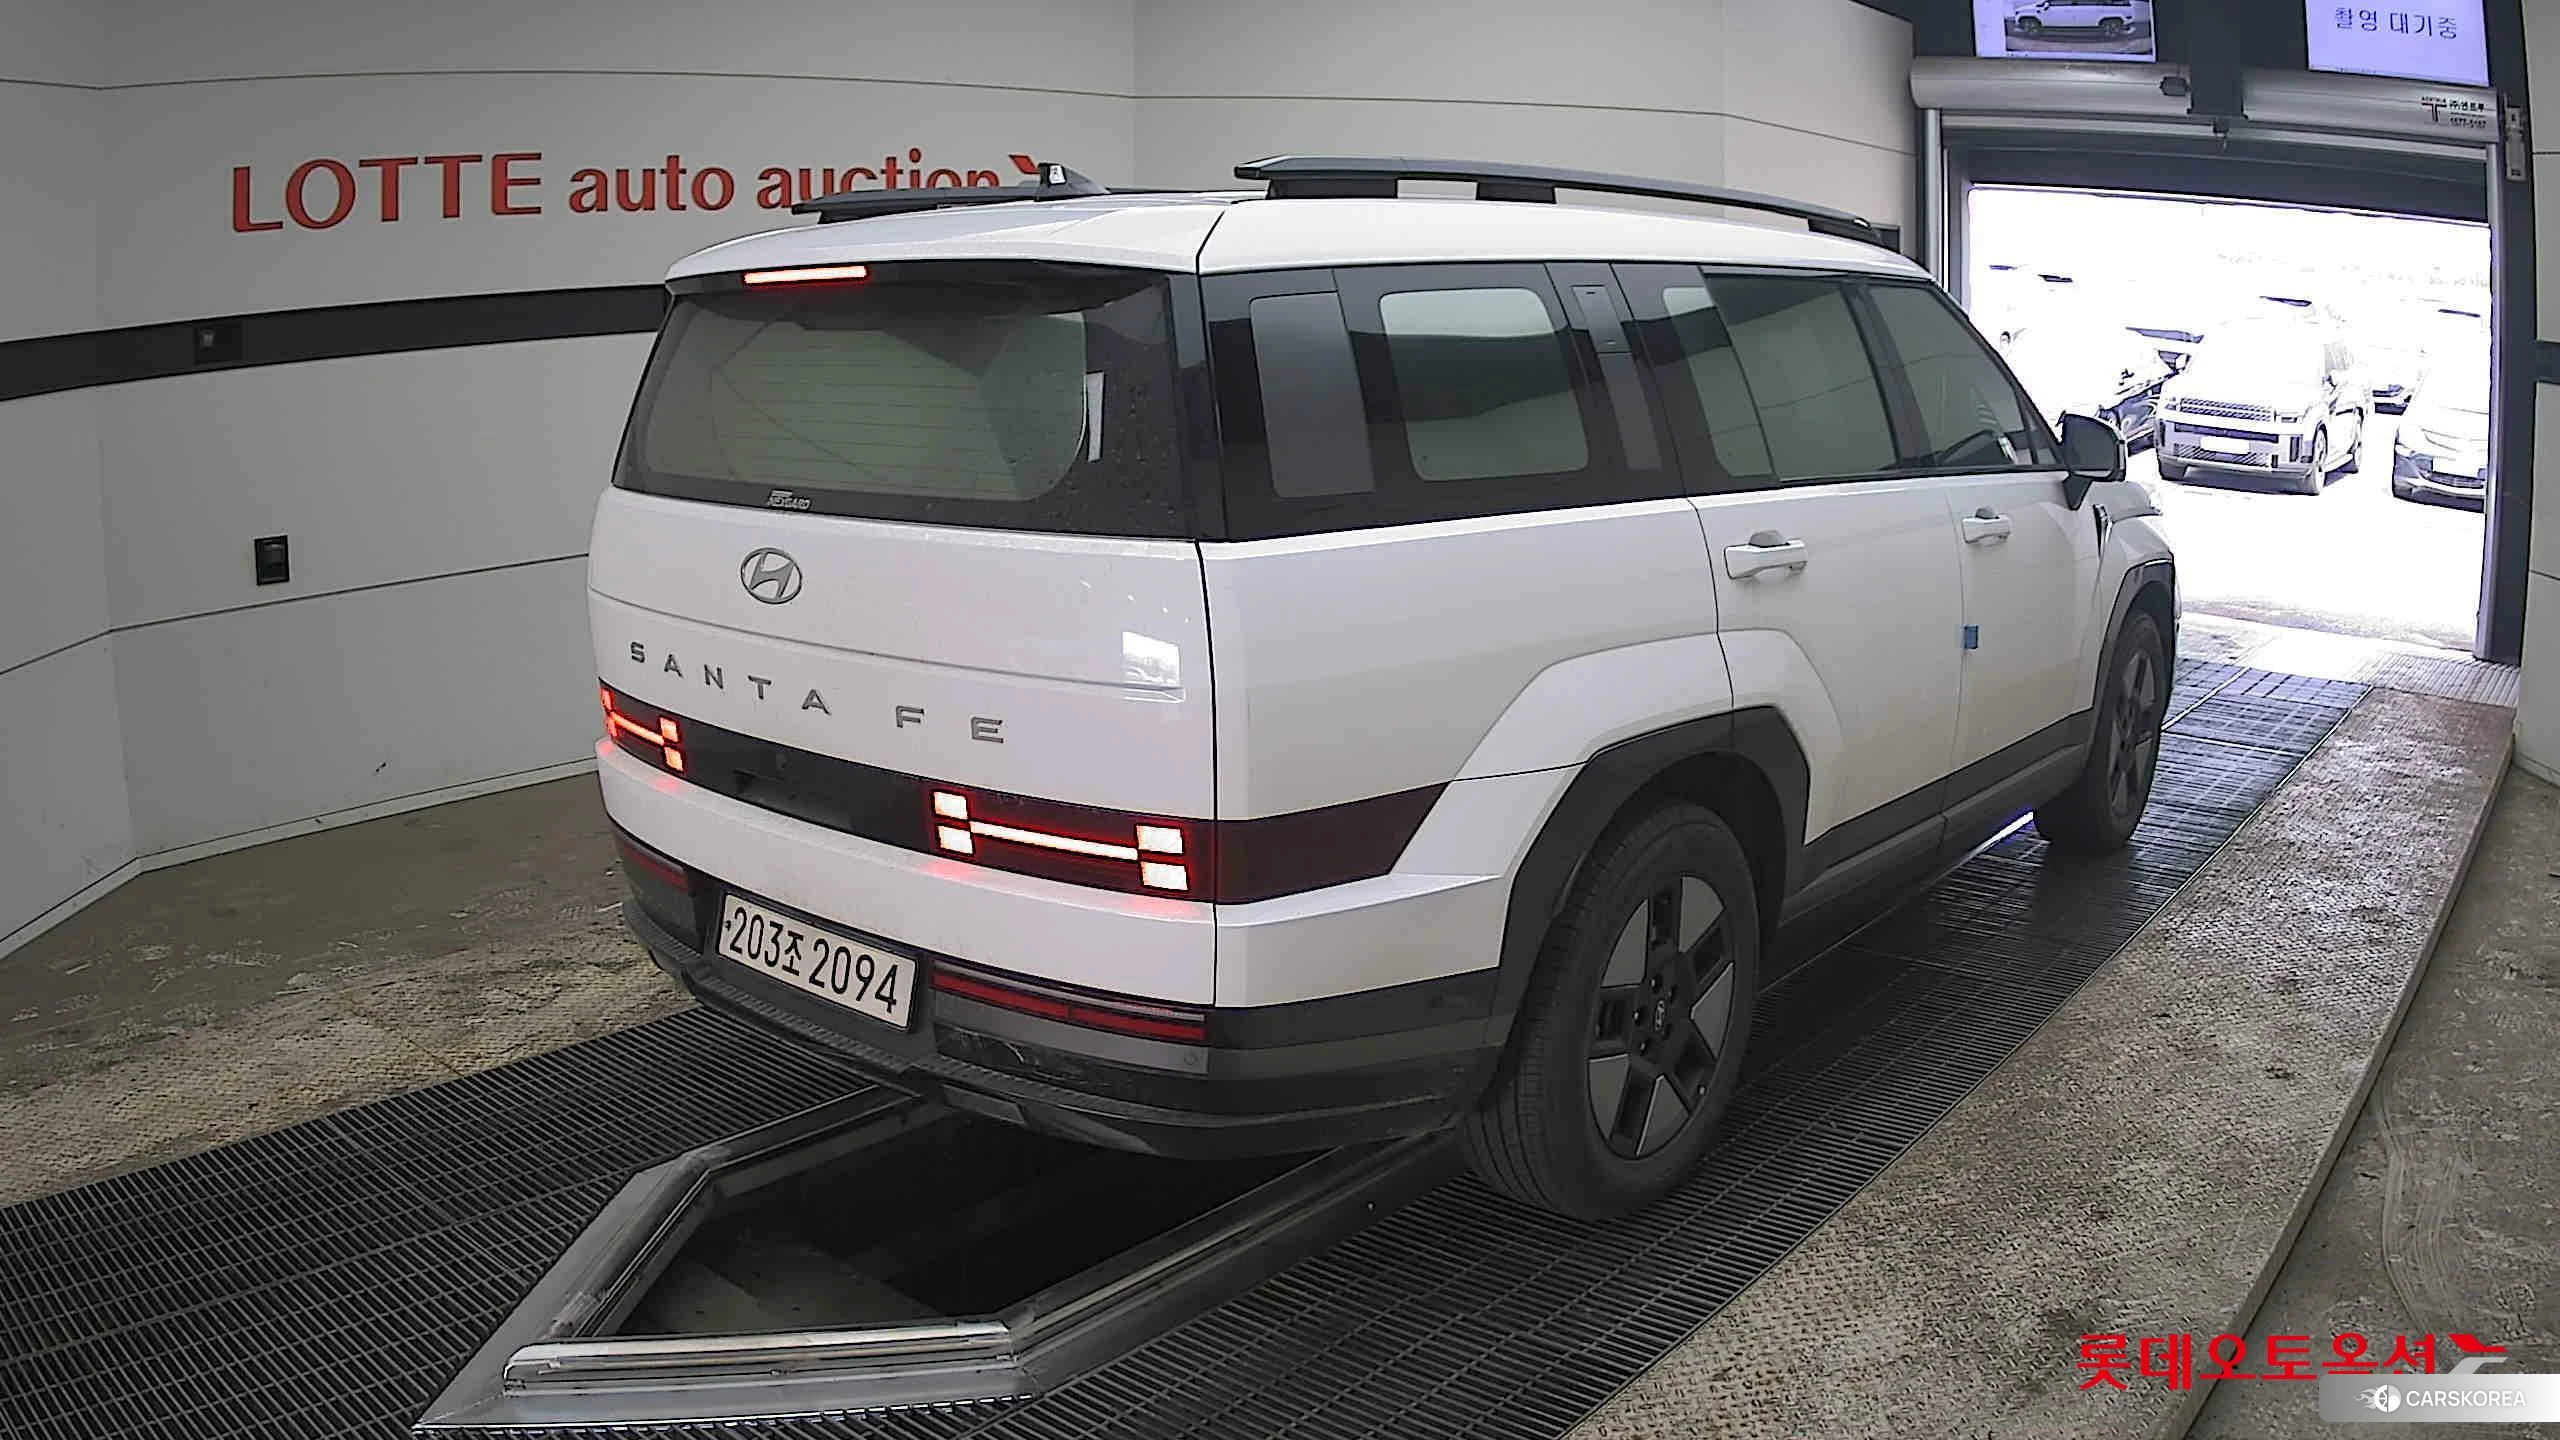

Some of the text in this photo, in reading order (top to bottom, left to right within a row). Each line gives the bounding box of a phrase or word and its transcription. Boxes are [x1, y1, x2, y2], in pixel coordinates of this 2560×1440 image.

[2389, 11, 2457, 40] 대기중
[232, 152, 543, 233] LOTTE
[568, 154, 736, 213] auto
[629, 641, 1004, 744] SANTA FE
[729, 906, 899, 1014] 203조 2094
